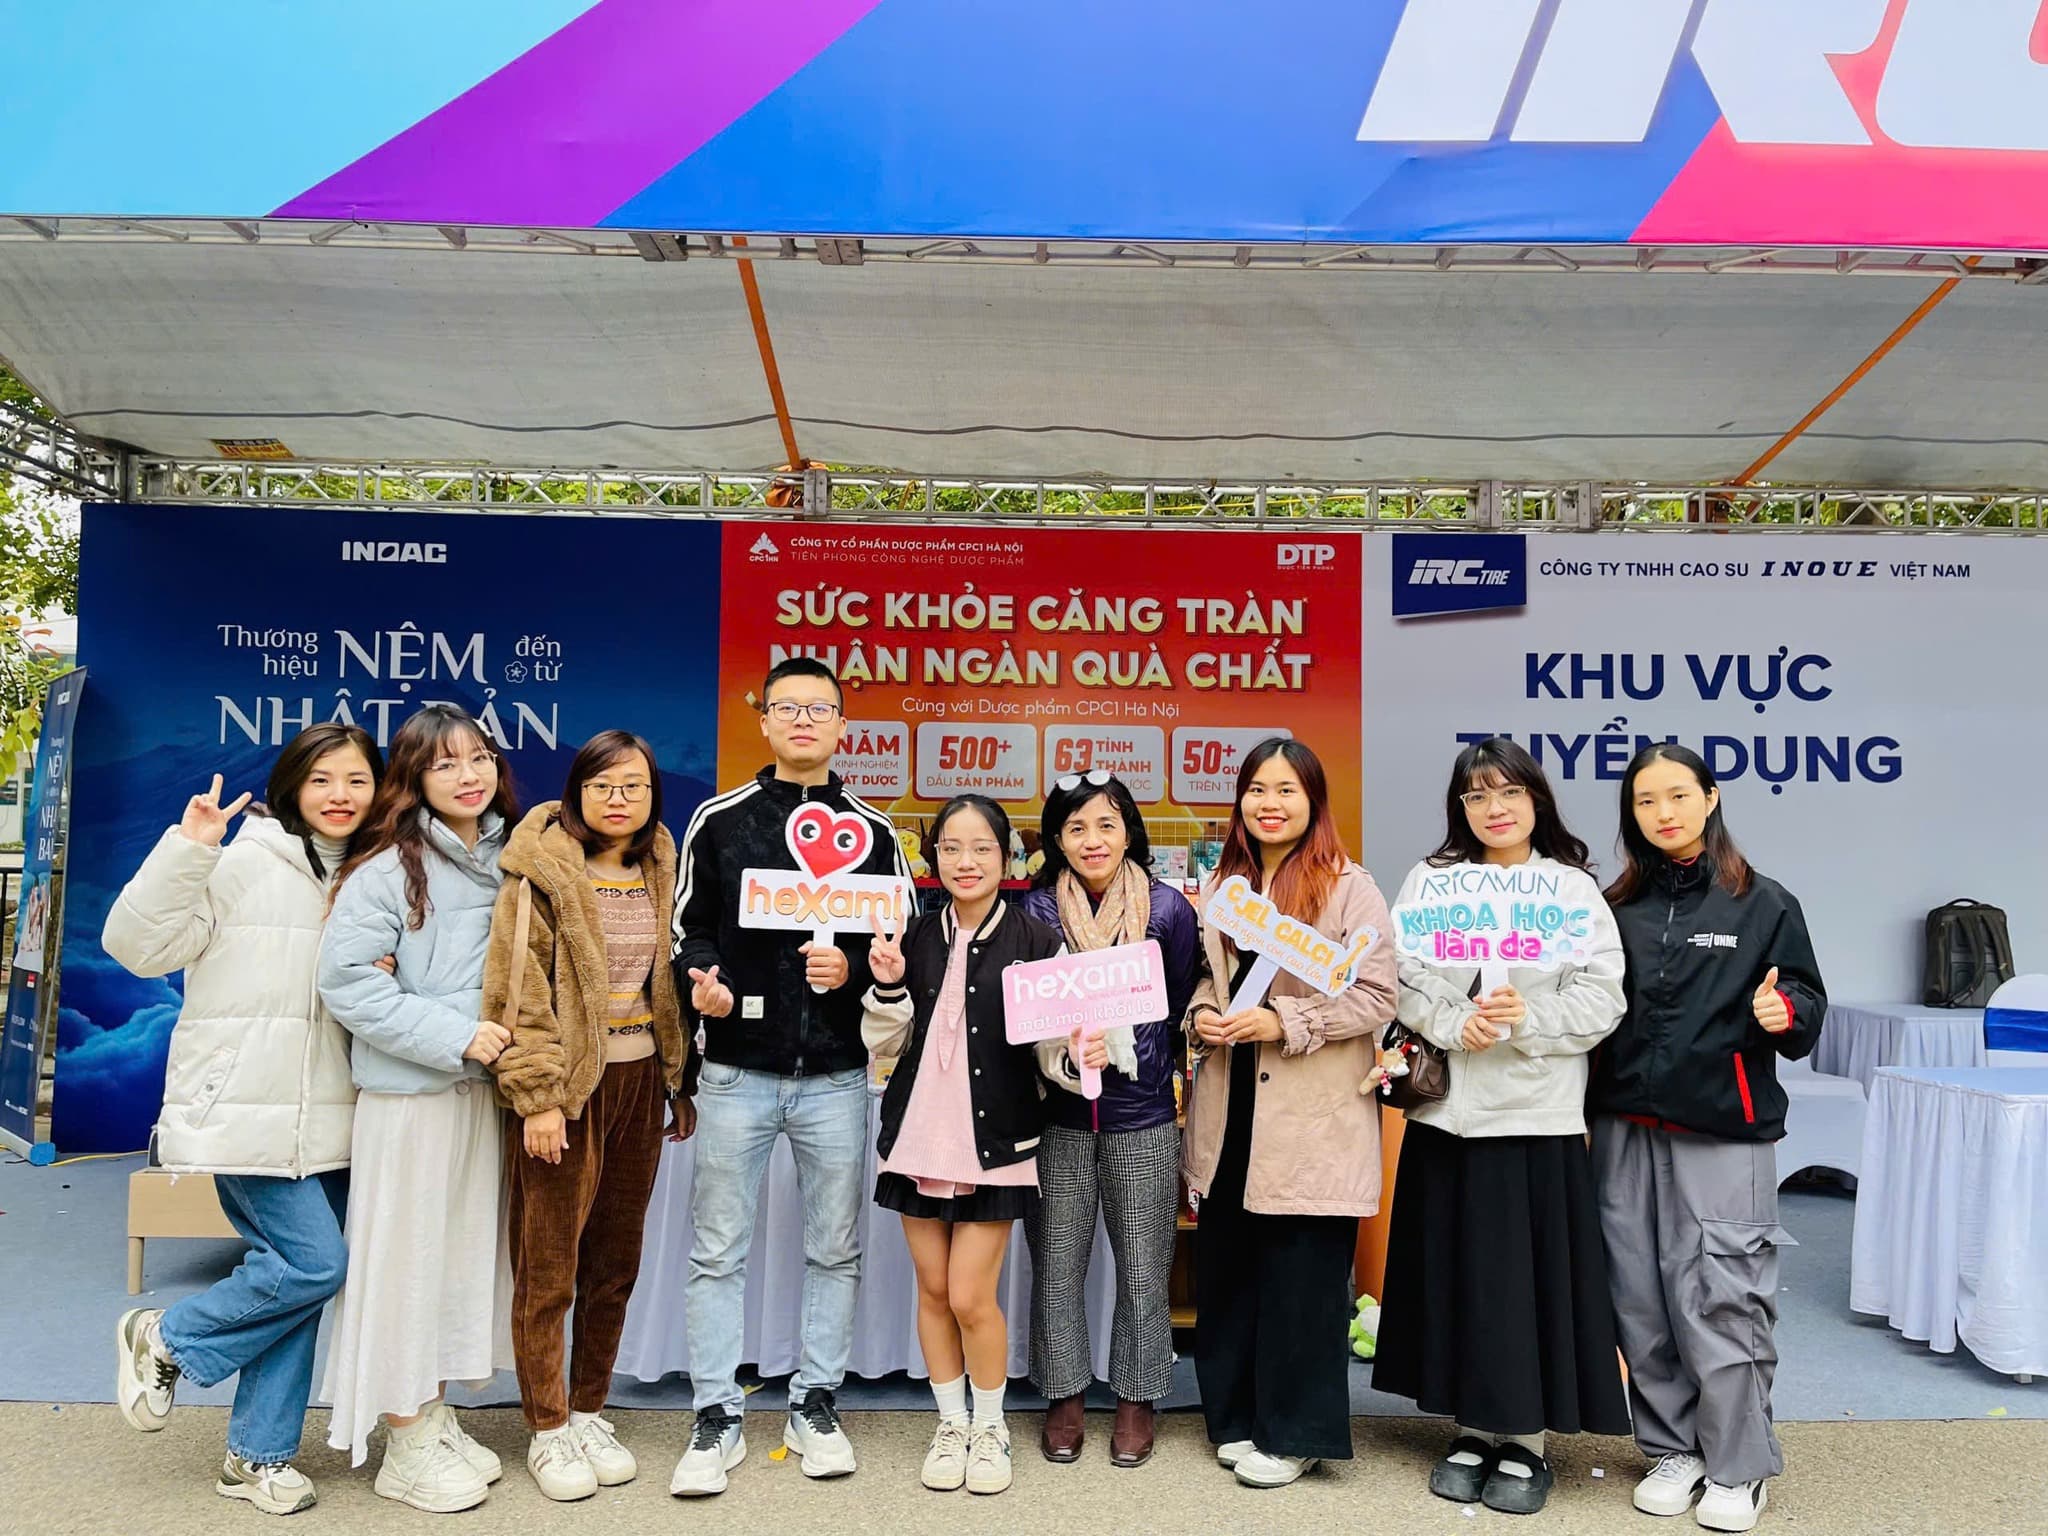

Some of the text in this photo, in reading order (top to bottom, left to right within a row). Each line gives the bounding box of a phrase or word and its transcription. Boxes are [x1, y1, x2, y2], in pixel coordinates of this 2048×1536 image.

[342, 541, 447, 563] INOAC
[790, 536, 821, 547] CÔNG
[825, 539, 838, 548] TY
[841, 535, 856, 549] CỔ
[891, 540, 922, 552] DƯỢC
[959, 542, 983, 552] CPC1
[986, 541, 1001, 552] HÀ
[1004, 541, 1023, 554] NỘI
[1277, 543, 1335, 565] DTP
[791, 550, 818, 561] TIÊN
[823, 552, 866, 562] PHONG
[872, 553, 906, 563] CÔNG
[1479, 570, 1510, 585] TIRE
[1540, 558, 1970, 580] CÔNG TY TNHH CAO SU INOUE VIỆT NAM
[776, 581, 1304, 636] SỨC KHỎE CĂNG TRÀN
[217, 624, 318, 655] Thương
[515, 634, 561, 657] đến
[263, 653, 318, 680] hiệu
[334, 620, 489, 693] NỆM
[923, 639, 1058, 686] NGÀN
[1071, 642, 1173, 688] QUÀ
[1184, 638, 1312, 690] CHẤT
[534, 660, 562, 681] từ
[1525, 645, 1833, 714] KHU VỰC
[902, 697, 1180, 718] Cùng với Dược phẩm CPC1 Hà Nội
[834, 729, 900, 756] NĂM
[939, 735, 1012, 770] 500+
[1096, 736, 1133, 753] TỈNH
[835, 759, 858, 769] KINH
[1054, 738, 1093, 772] 63
[1096, 759, 1151, 773] THÀNH
[1183, 740, 1236, 775] 50+
[1703, 736, 1903, 795] DỤNG
[862, 773, 898, 786] DƯỢC
[955, 772, 982, 787] SẢN
[1188, 779, 1221, 791] TRÊN
[1400, 902, 1590, 939] KHOA HỌC
[1274, 920, 1337, 968] CALCI
[1433, 928, 1543, 961] làn da
[1130, 984, 1152, 994] PLUS
